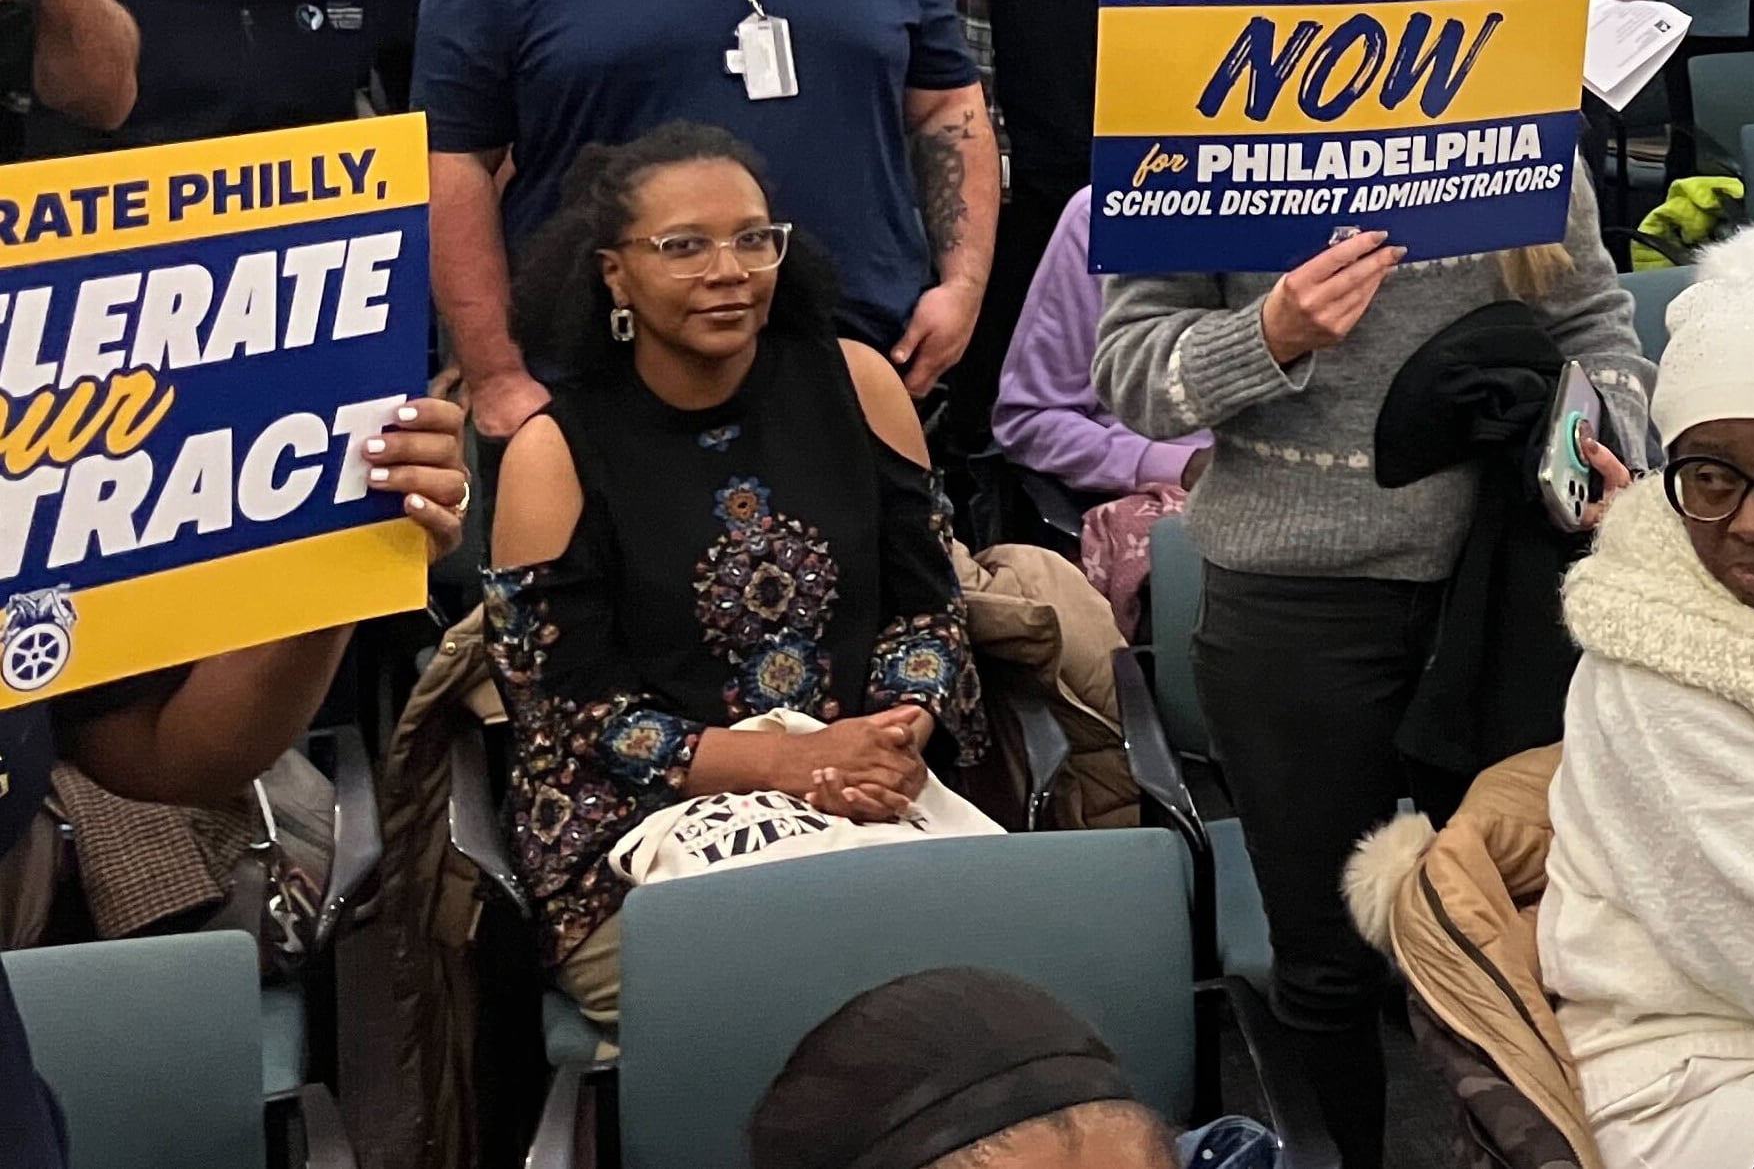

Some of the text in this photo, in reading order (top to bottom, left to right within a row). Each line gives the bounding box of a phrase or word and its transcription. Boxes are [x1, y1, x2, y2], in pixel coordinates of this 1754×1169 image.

[1196, 11, 1504, 122] NOW
[168, 148, 387, 222] PHILLY,
[1102, 163, 1563, 218] SCHOOL DISTRICT ADMINISTRATORS
[1131, 123, 1544, 188] for PHILADELPHIA
[0, 230, 403, 399] LERATE
